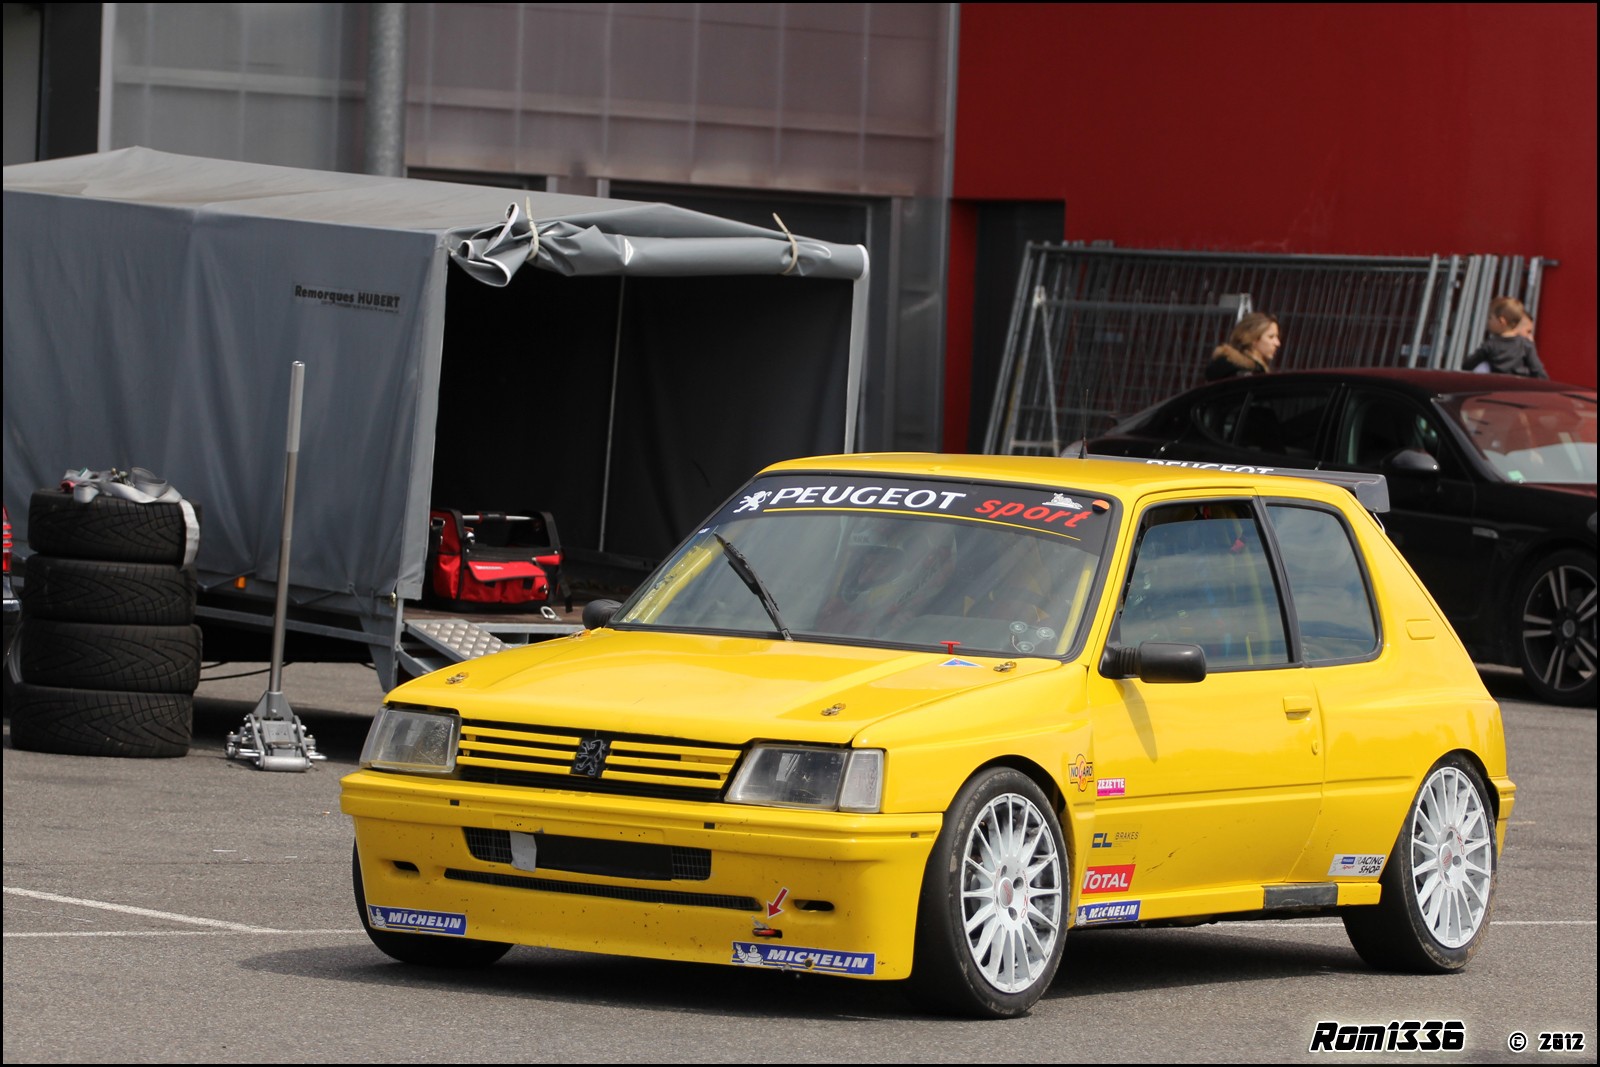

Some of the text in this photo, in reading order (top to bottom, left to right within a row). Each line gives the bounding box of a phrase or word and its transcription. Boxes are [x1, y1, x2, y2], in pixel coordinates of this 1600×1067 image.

[294, 285, 354, 303] Remorques
[357, 292, 401, 308] HUBERT
[769, 485, 1094, 528] PEUGEOT sport
[1097, 778, 1125, 789] ZEZETTE
[1091, 832, 1113, 848] CL
[1115, 831, 1140, 840] BRAKES
[1358, 865, 1381, 874] SHOP
[1082, 870, 1128, 890] TOTAL
[388, 911, 462, 929] MICHELIN
[1088, 904, 1138, 918] MICHELIN
[766, 949, 869, 968] MICHELIN
